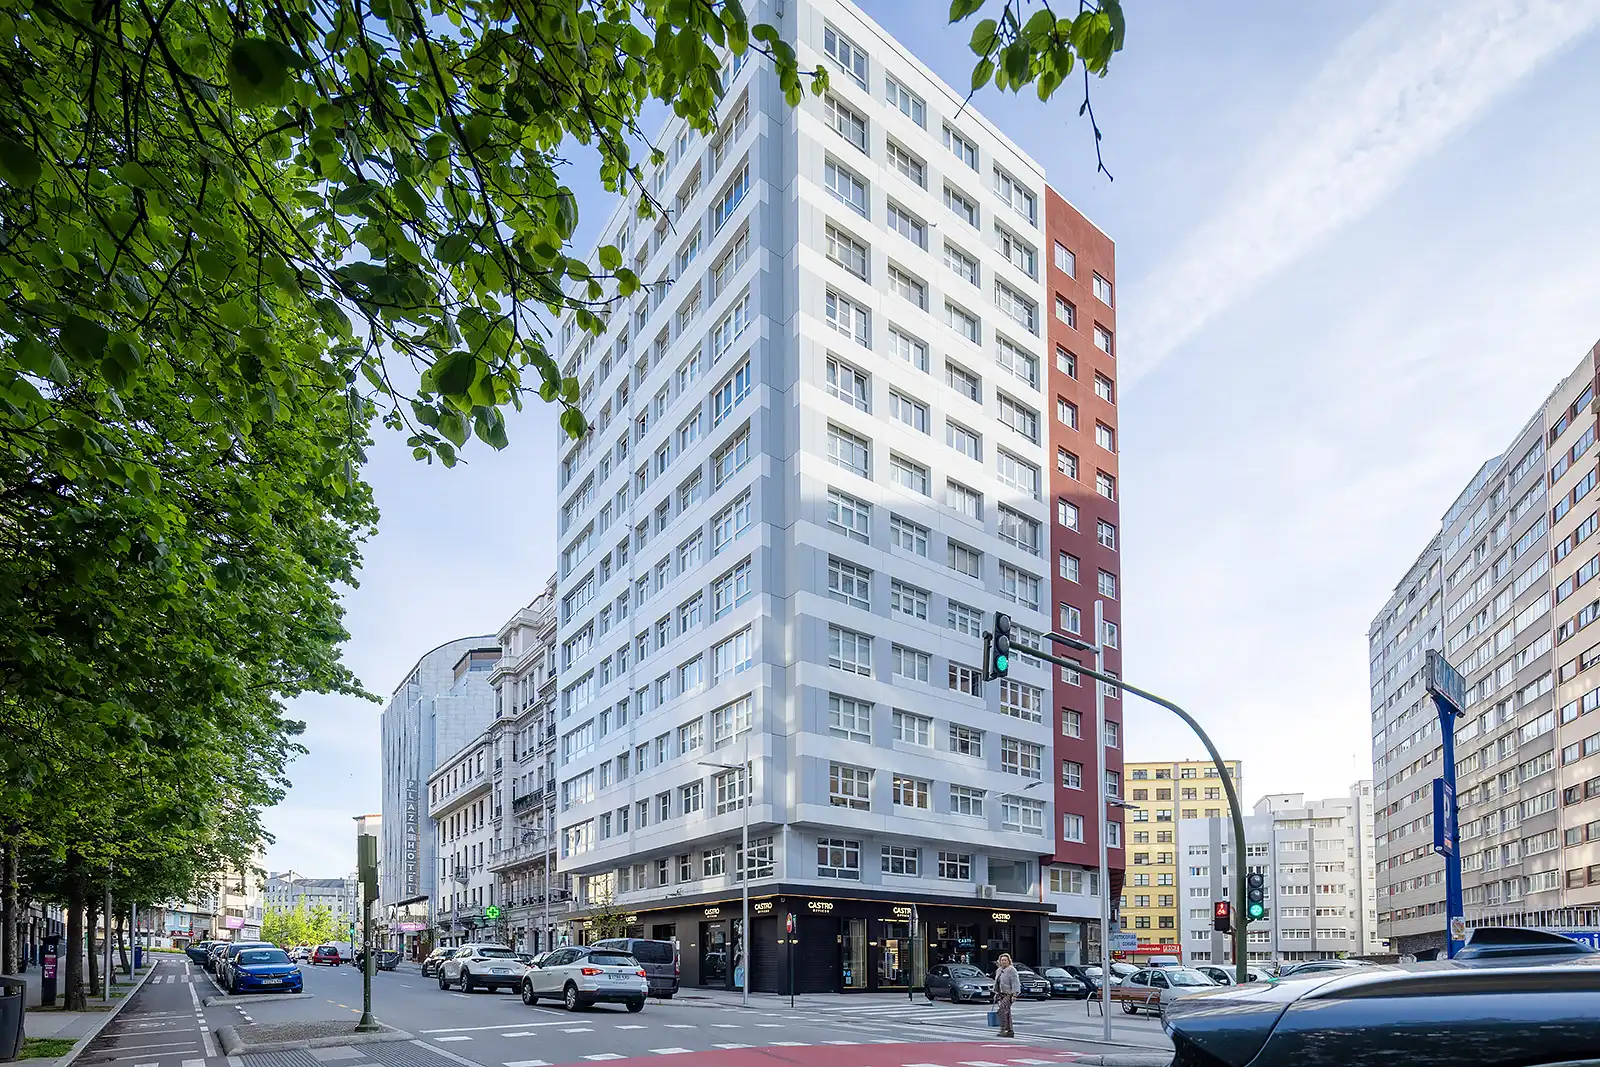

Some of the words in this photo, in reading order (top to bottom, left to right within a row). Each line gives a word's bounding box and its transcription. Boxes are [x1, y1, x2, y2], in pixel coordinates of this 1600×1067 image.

[407, 781, 415, 834] PLAZA
[407, 841, 415, 893] HOTEL
[754, 902, 773, 911] CASTRO
[808, 901, 834, 910] CASTRO
[704, 907, 720, 916] CASTRO
[893, 907, 912, 915] CASTR
